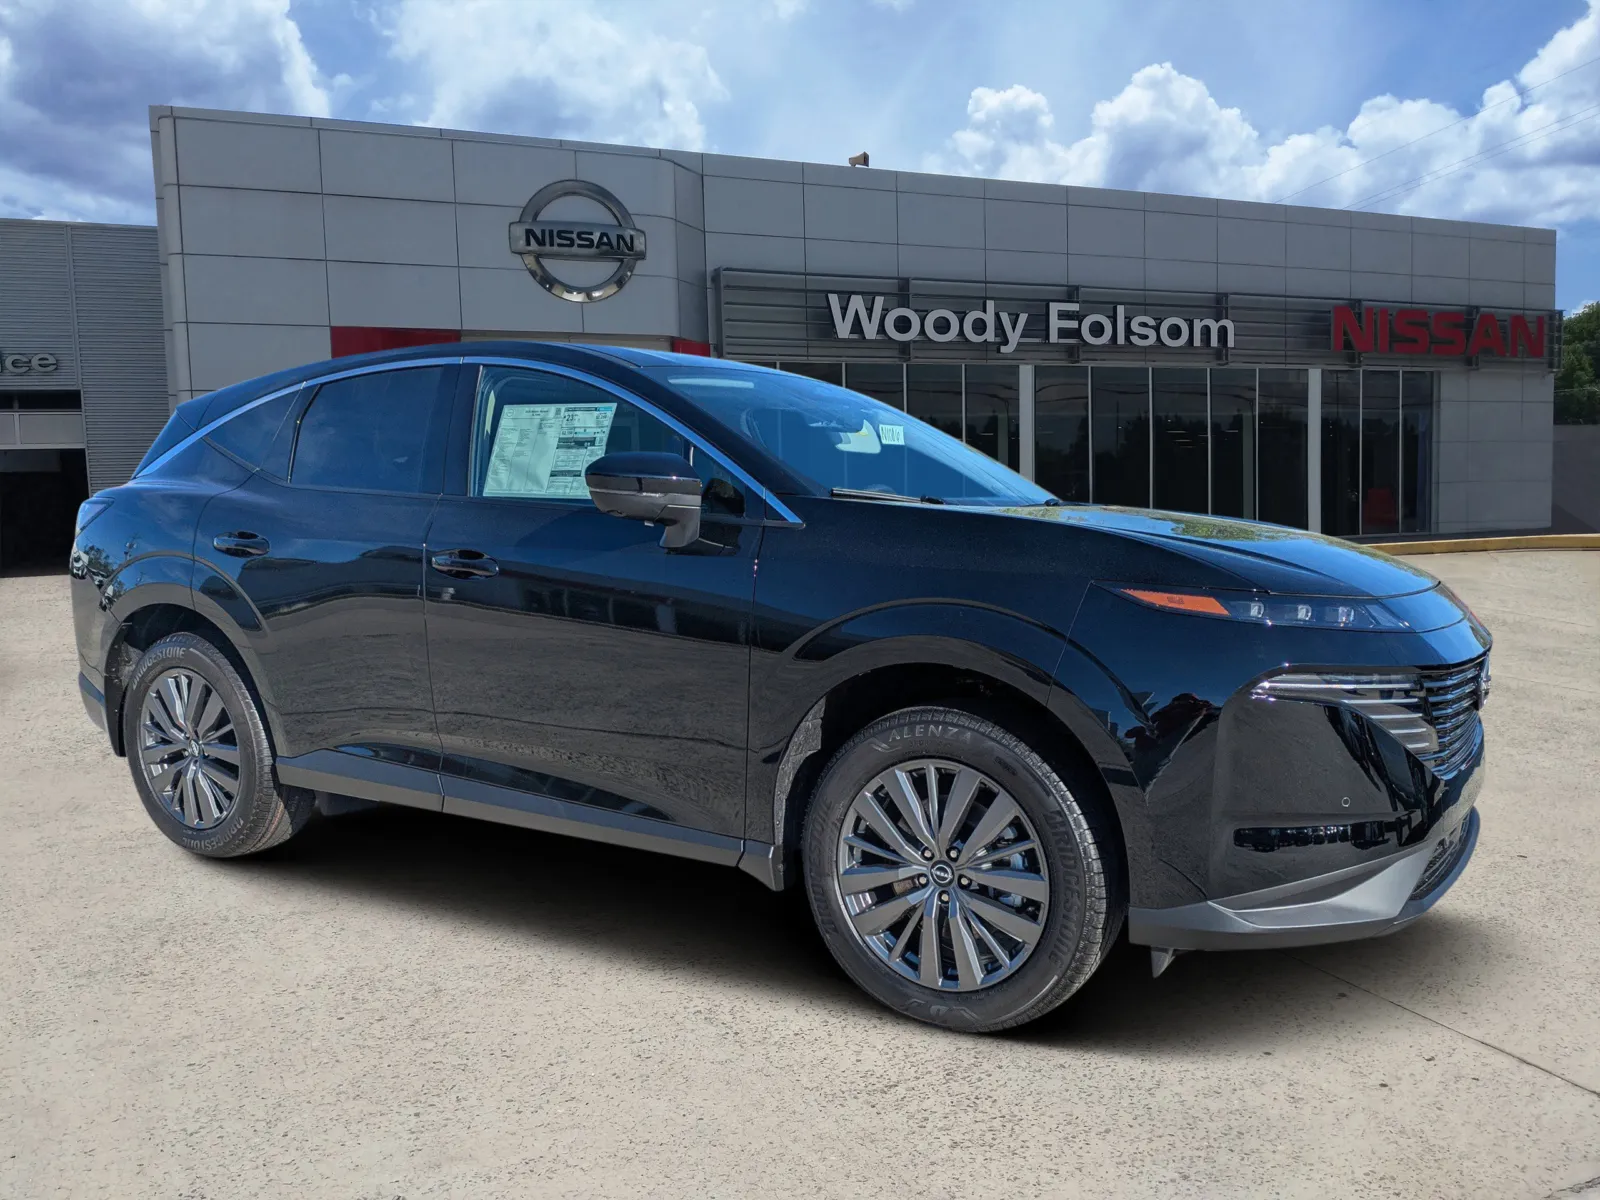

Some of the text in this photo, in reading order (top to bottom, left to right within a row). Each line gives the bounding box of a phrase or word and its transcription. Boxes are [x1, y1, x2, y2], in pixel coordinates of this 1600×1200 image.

[524, 228, 635, 253] NISSAN
[827, 293, 1236, 354] Woody Folsom
[1332, 304, 1546, 359] NISSAN
[888, 724, 973, 745] ALENZA
